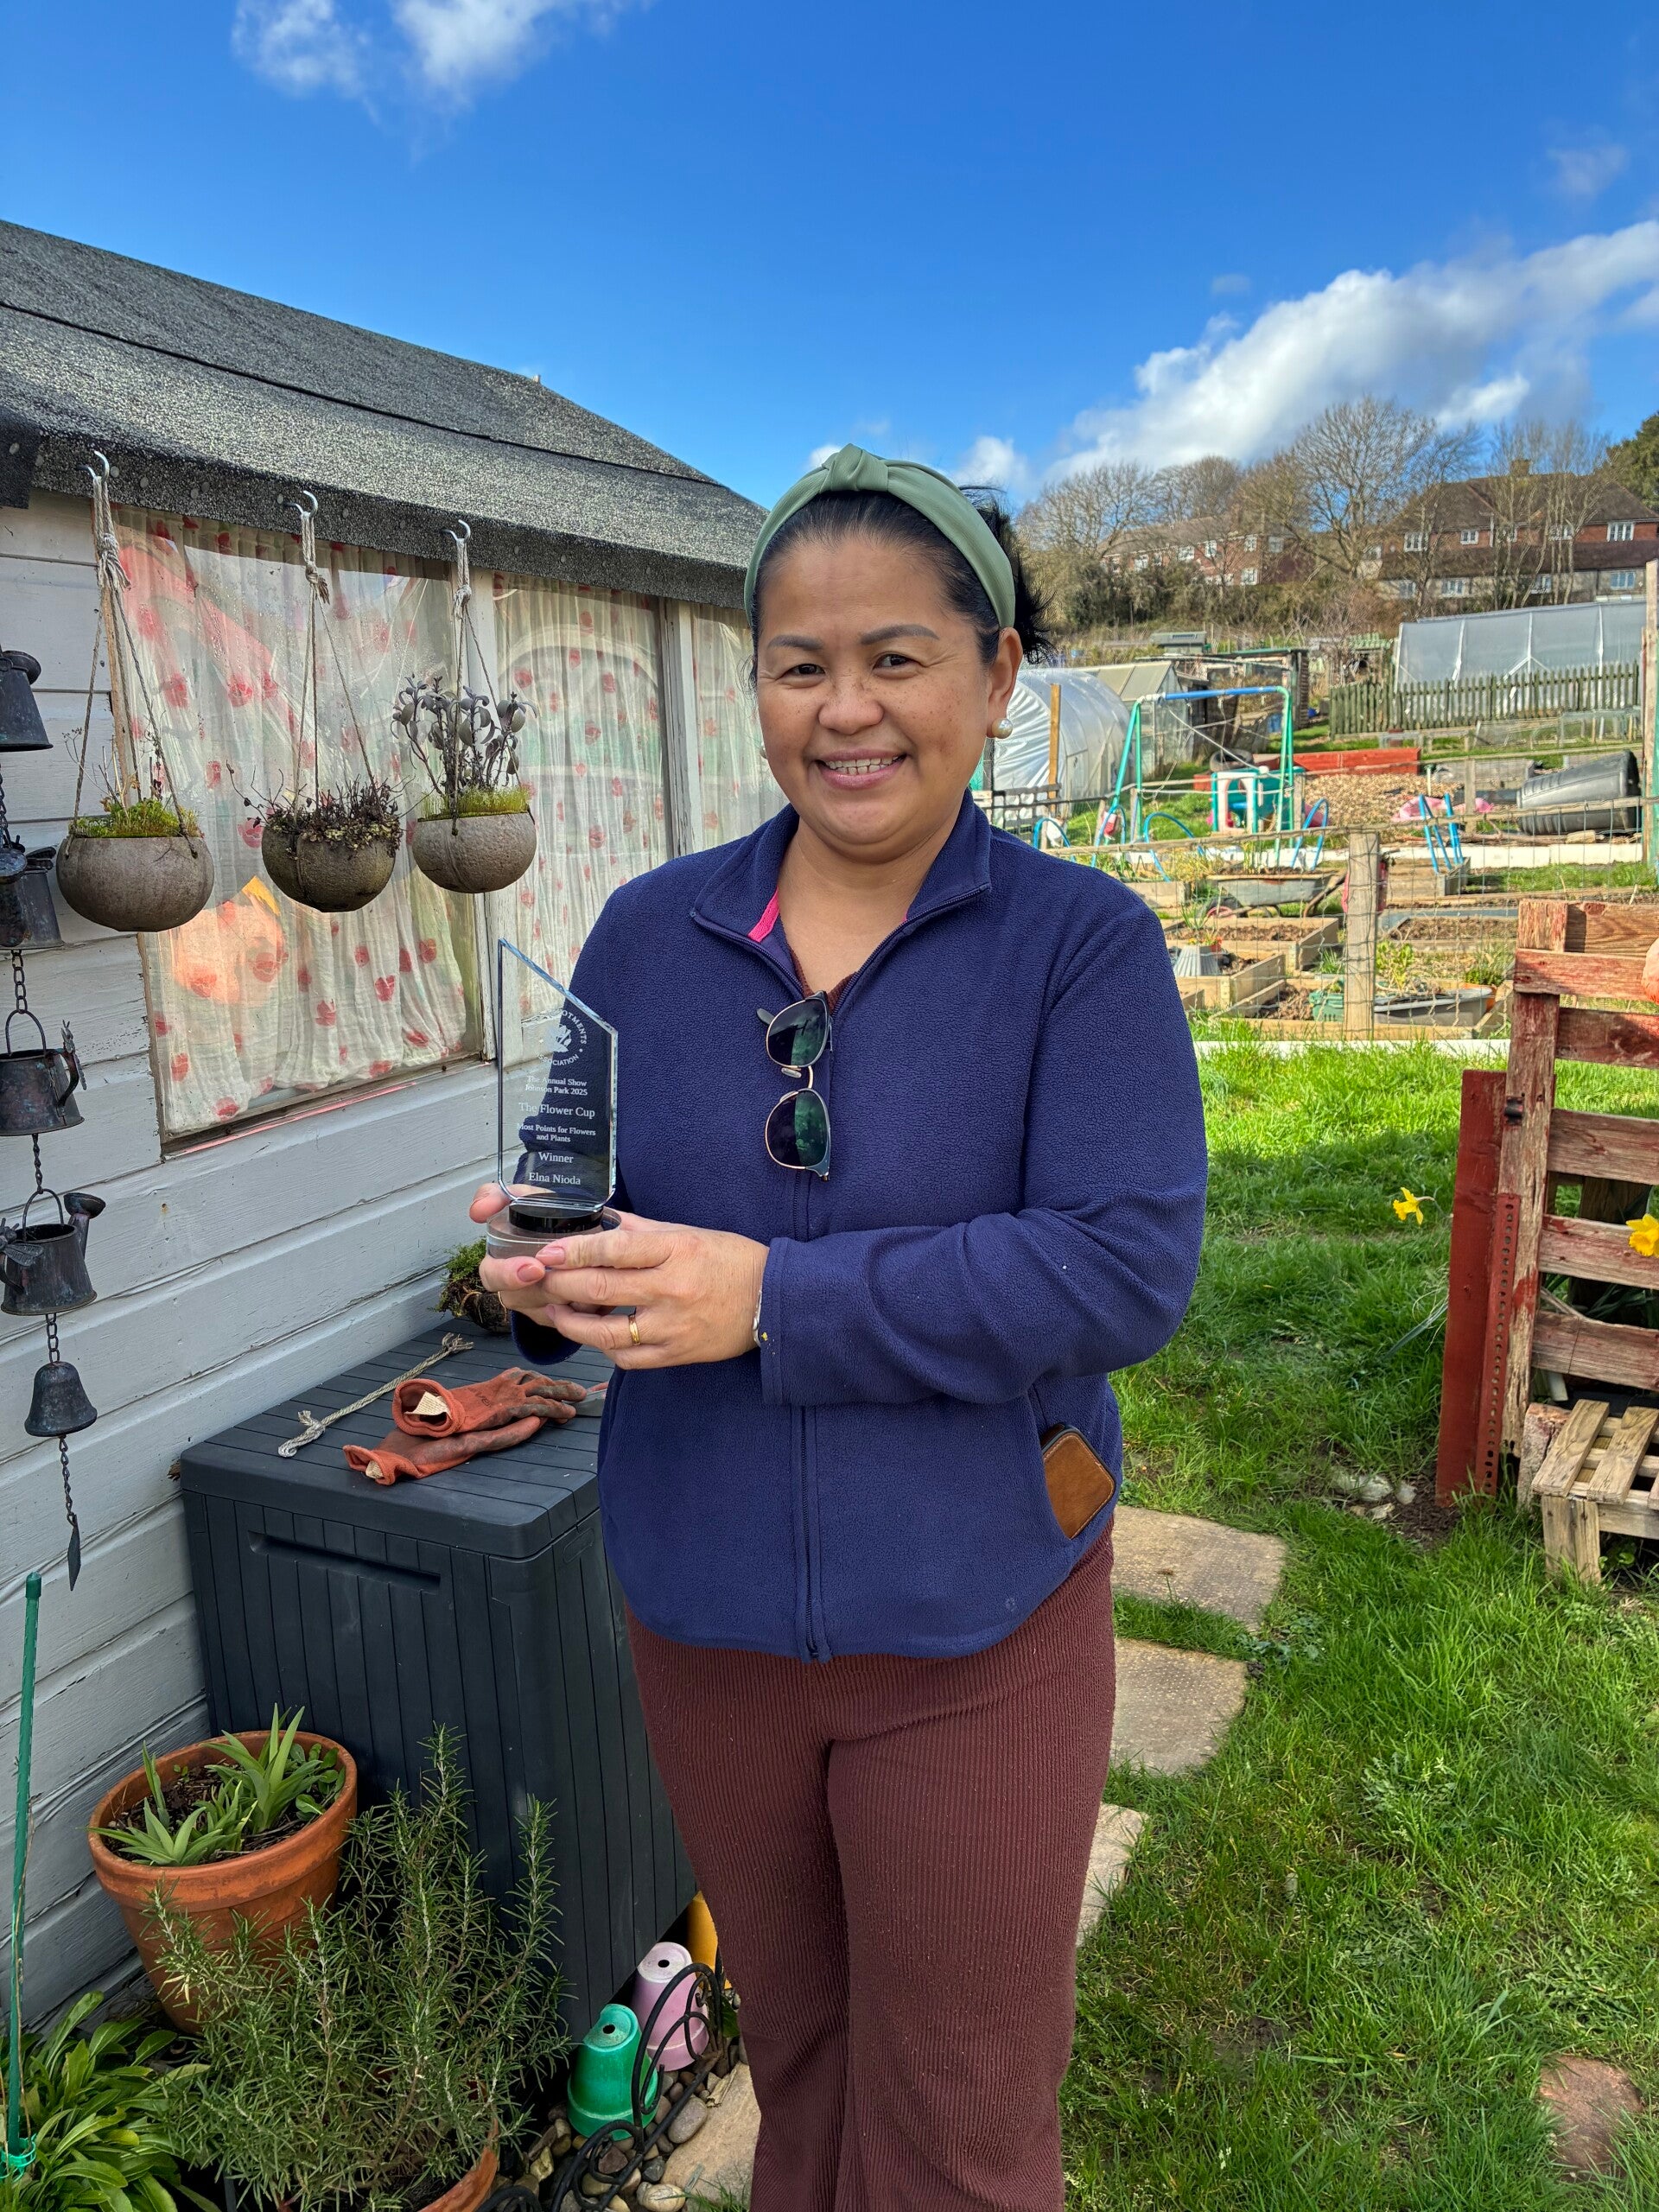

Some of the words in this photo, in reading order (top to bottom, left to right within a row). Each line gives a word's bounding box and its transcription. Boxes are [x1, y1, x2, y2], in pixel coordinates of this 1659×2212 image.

[543, 1077, 566, 1085] Annual
[568, 1078, 588, 1087] Show
[525, 1084, 552, 1093] Johnson
[554, 1086, 569, 1095] Park
[518, 1102, 537, 1112] The
[540, 1103, 573, 1116] Flower
[575, 1107, 595, 1119] Cup
[535, 1124, 556, 1133] Points
[569, 1127, 596, 1136] Flowers
[550, 1134, 571, 1142] Plants
[538, 1151, 574, 1163] Winner
[528, 1172, 550, 1183] Elna
[552, 1173, 582, 1185] Nioda
